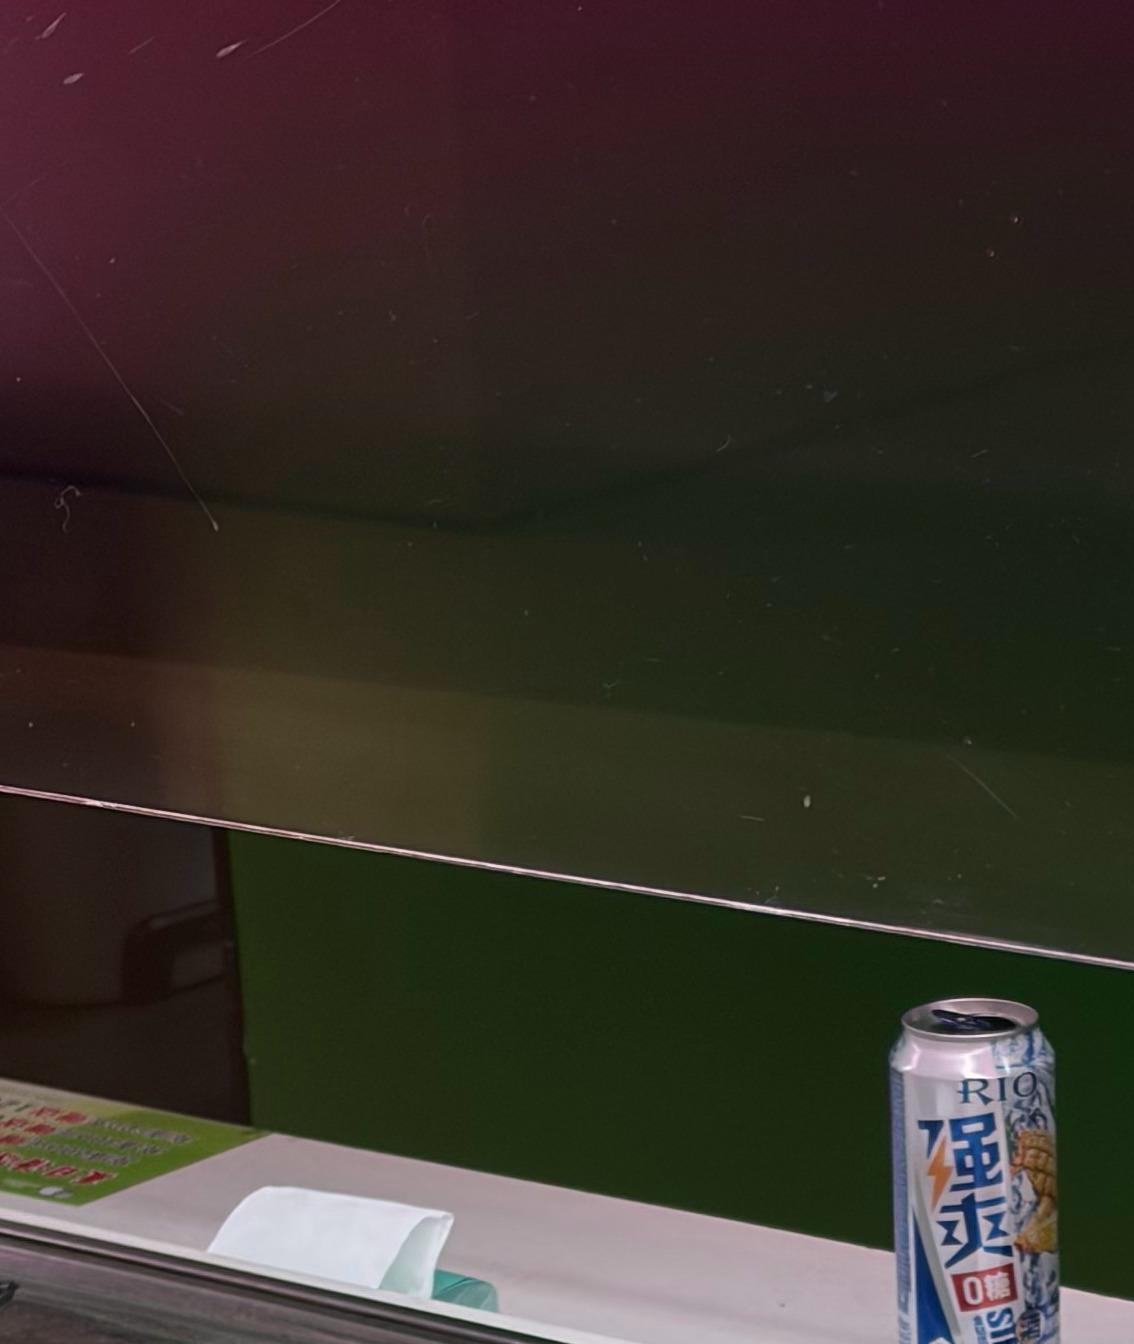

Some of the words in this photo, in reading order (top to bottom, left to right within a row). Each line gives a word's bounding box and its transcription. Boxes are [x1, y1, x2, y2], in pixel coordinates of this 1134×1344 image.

[957, 1071, 1038, 1105] RIO
[917, 1112, 1015, 1269] 强爽
[963, 1272, 1011, 1305] 0糖
